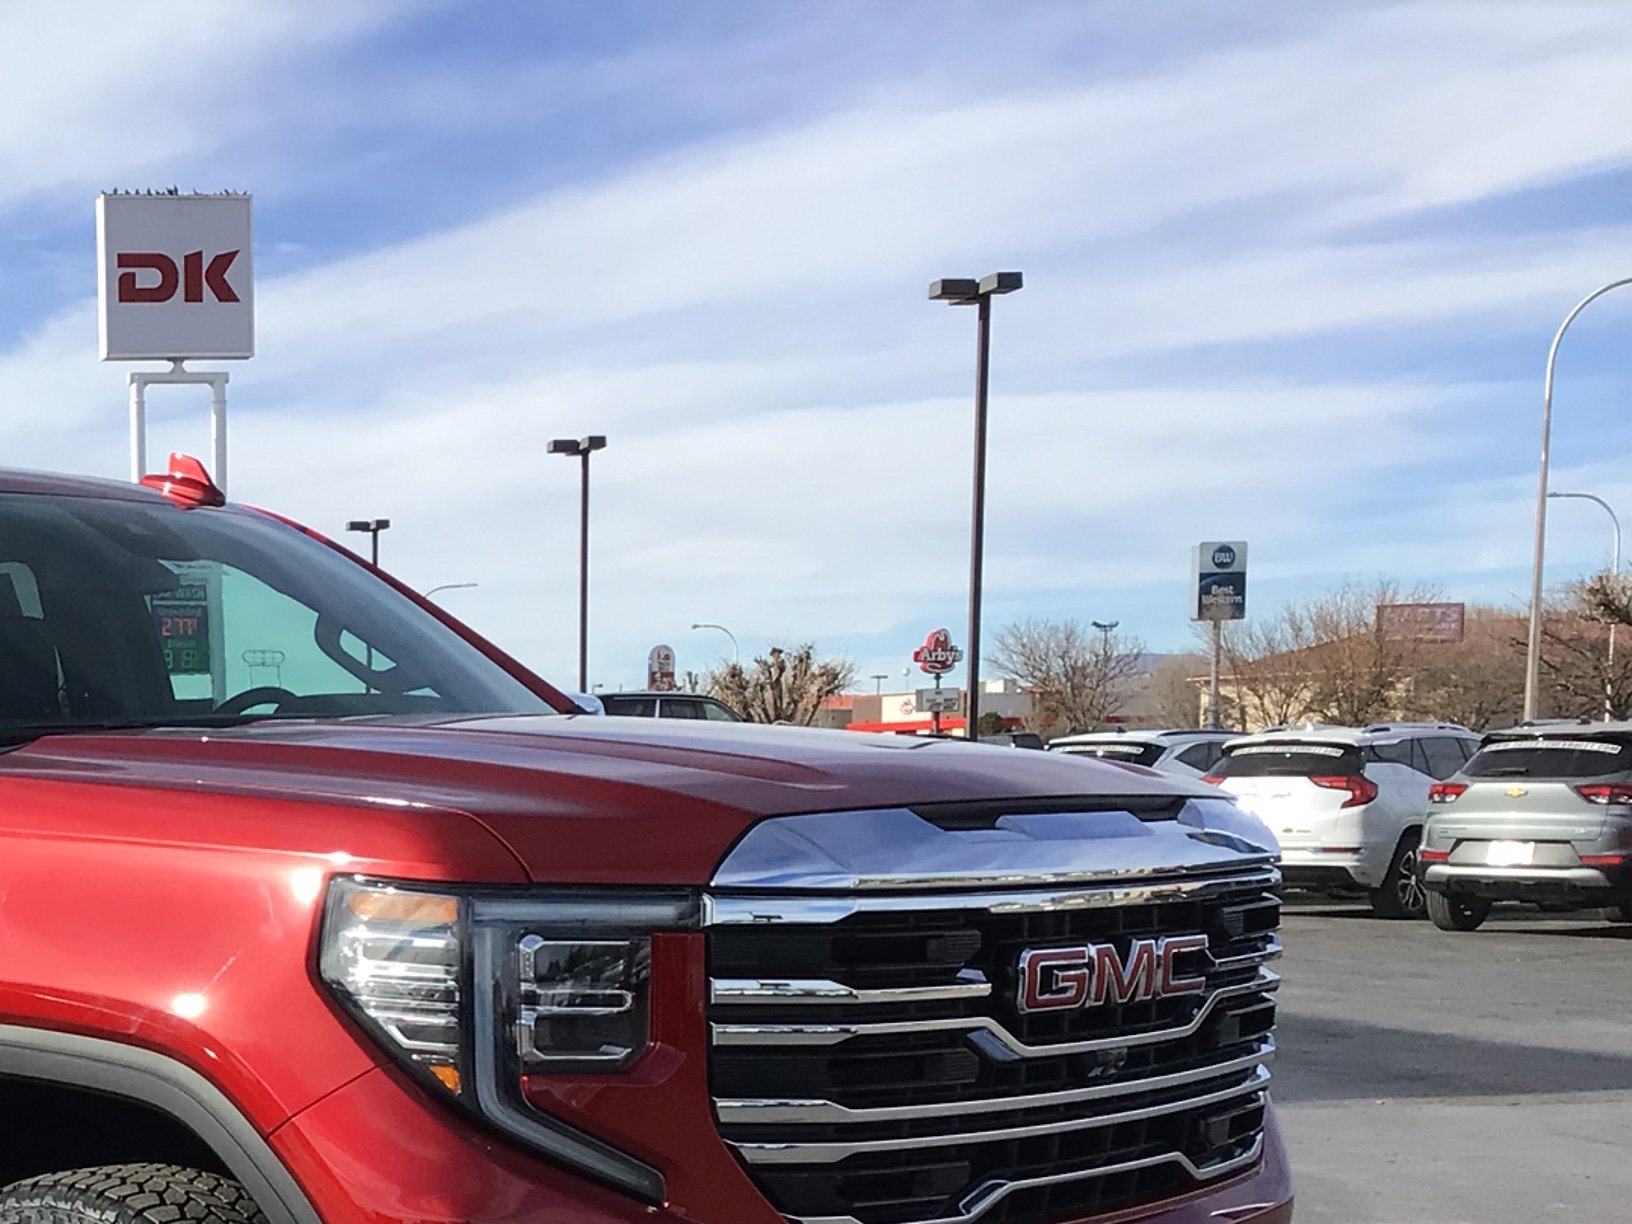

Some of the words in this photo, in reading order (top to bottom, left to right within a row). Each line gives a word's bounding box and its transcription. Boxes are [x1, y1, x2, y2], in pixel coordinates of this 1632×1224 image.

[116, 249, 241, 303] DK
[1211, 584, 1234, 595] Best
[1019, 934, 1209, 1015] GMC
